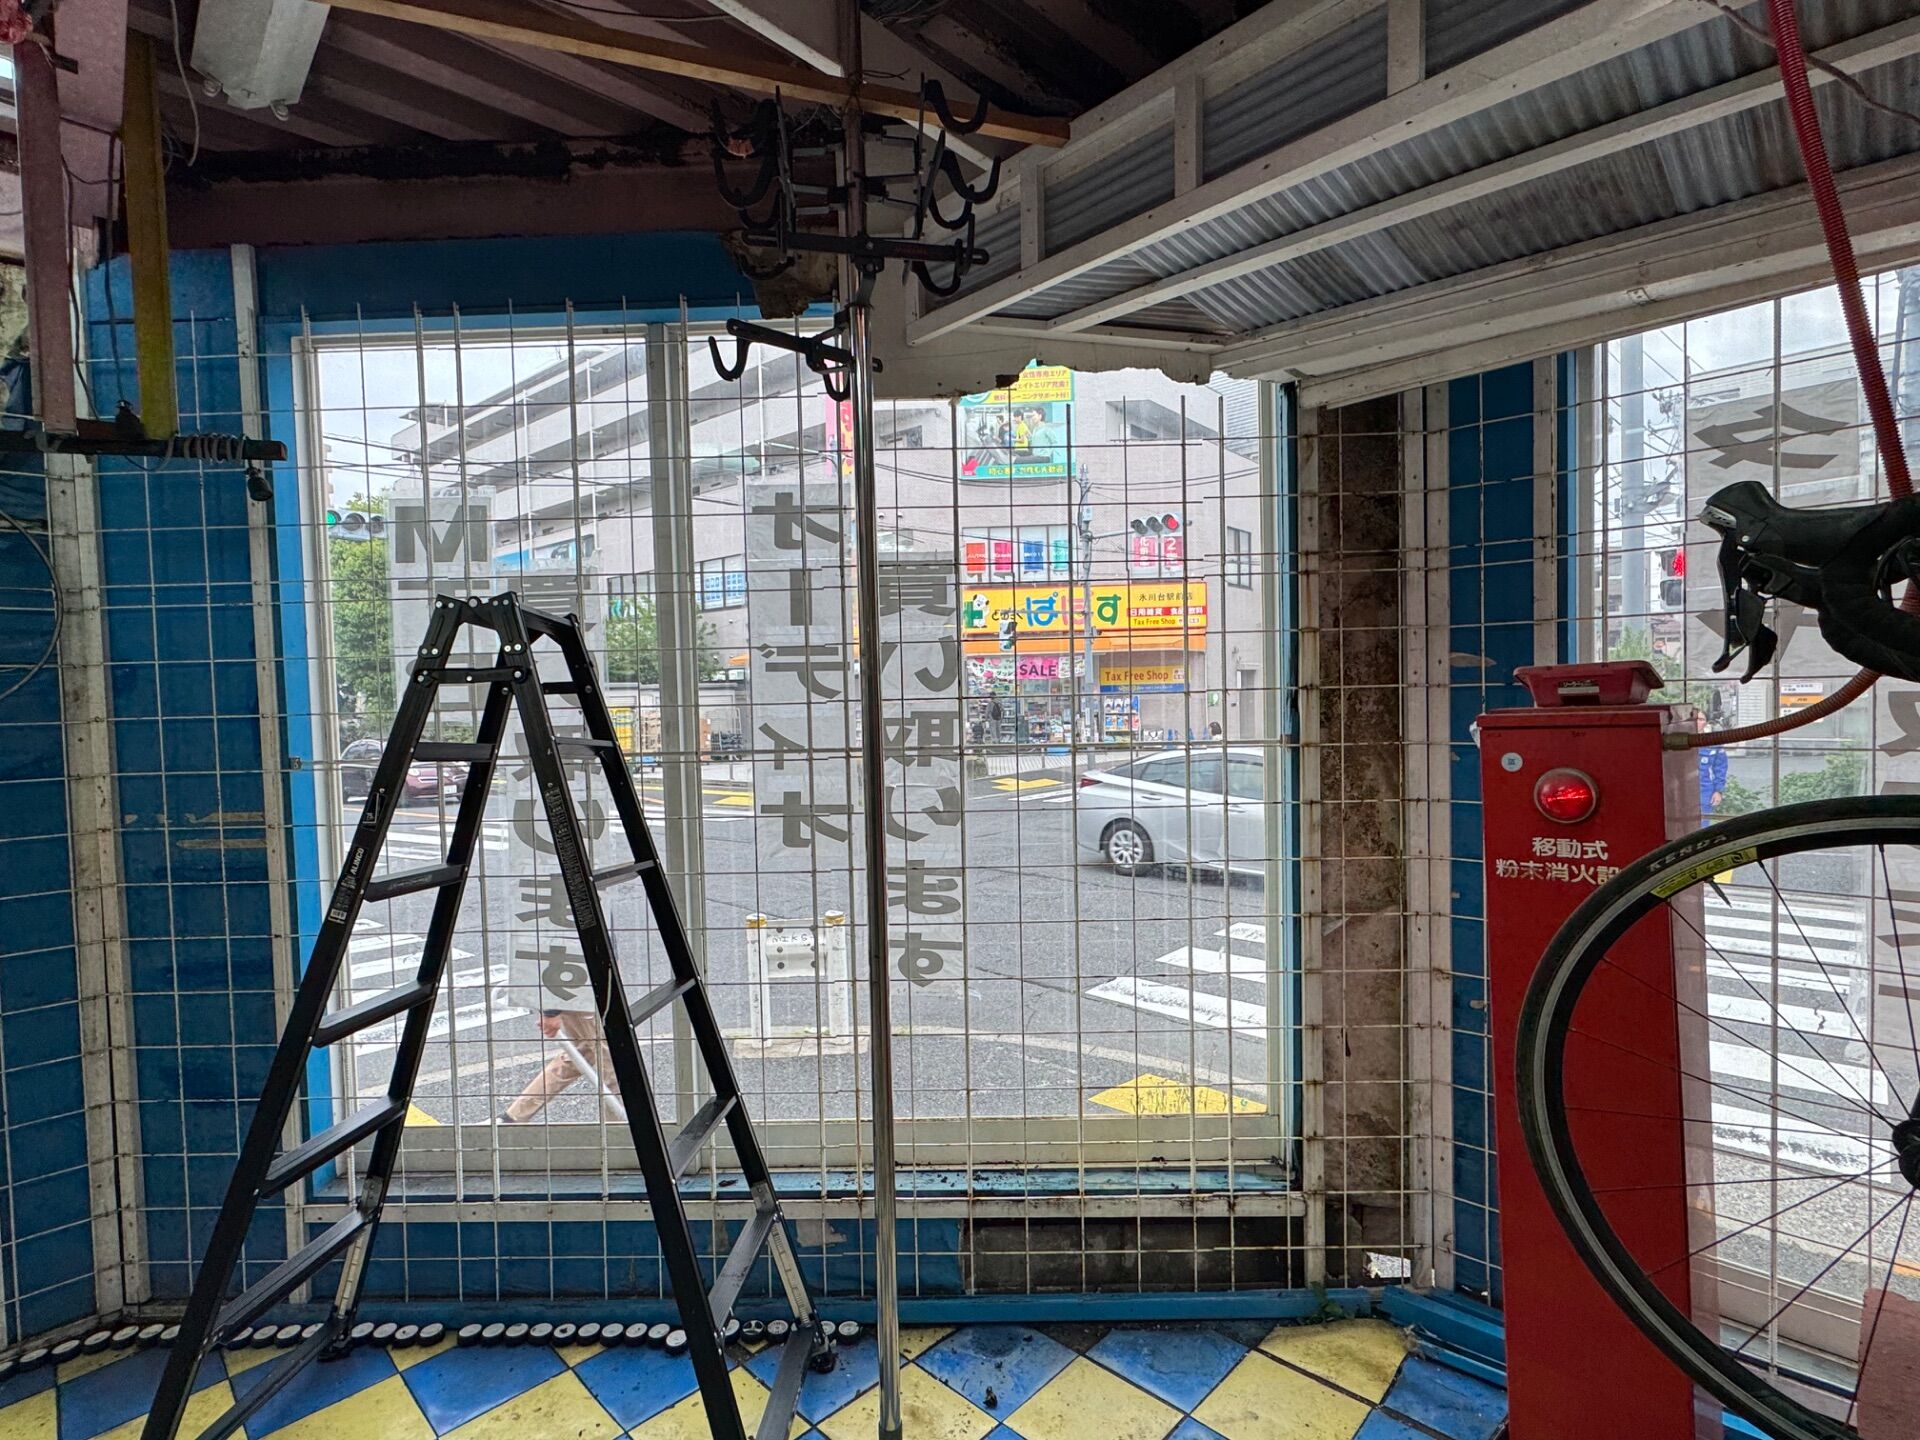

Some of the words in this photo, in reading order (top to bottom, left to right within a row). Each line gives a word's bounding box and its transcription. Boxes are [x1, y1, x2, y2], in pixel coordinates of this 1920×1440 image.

[1133, 618, 1145, 626] Tax
[1146, 618, 1160, 626] Free
[1161, 617, 1176, 626] Shop
[1019, 664, 1057, 677] SALE
[1105, 671, 1122, 681] Tax
[1147, 670, 1169, 682] Shop
[1531, 836, 1610, 861] 移動式
[350, 847, 365, 876] ALINCO
